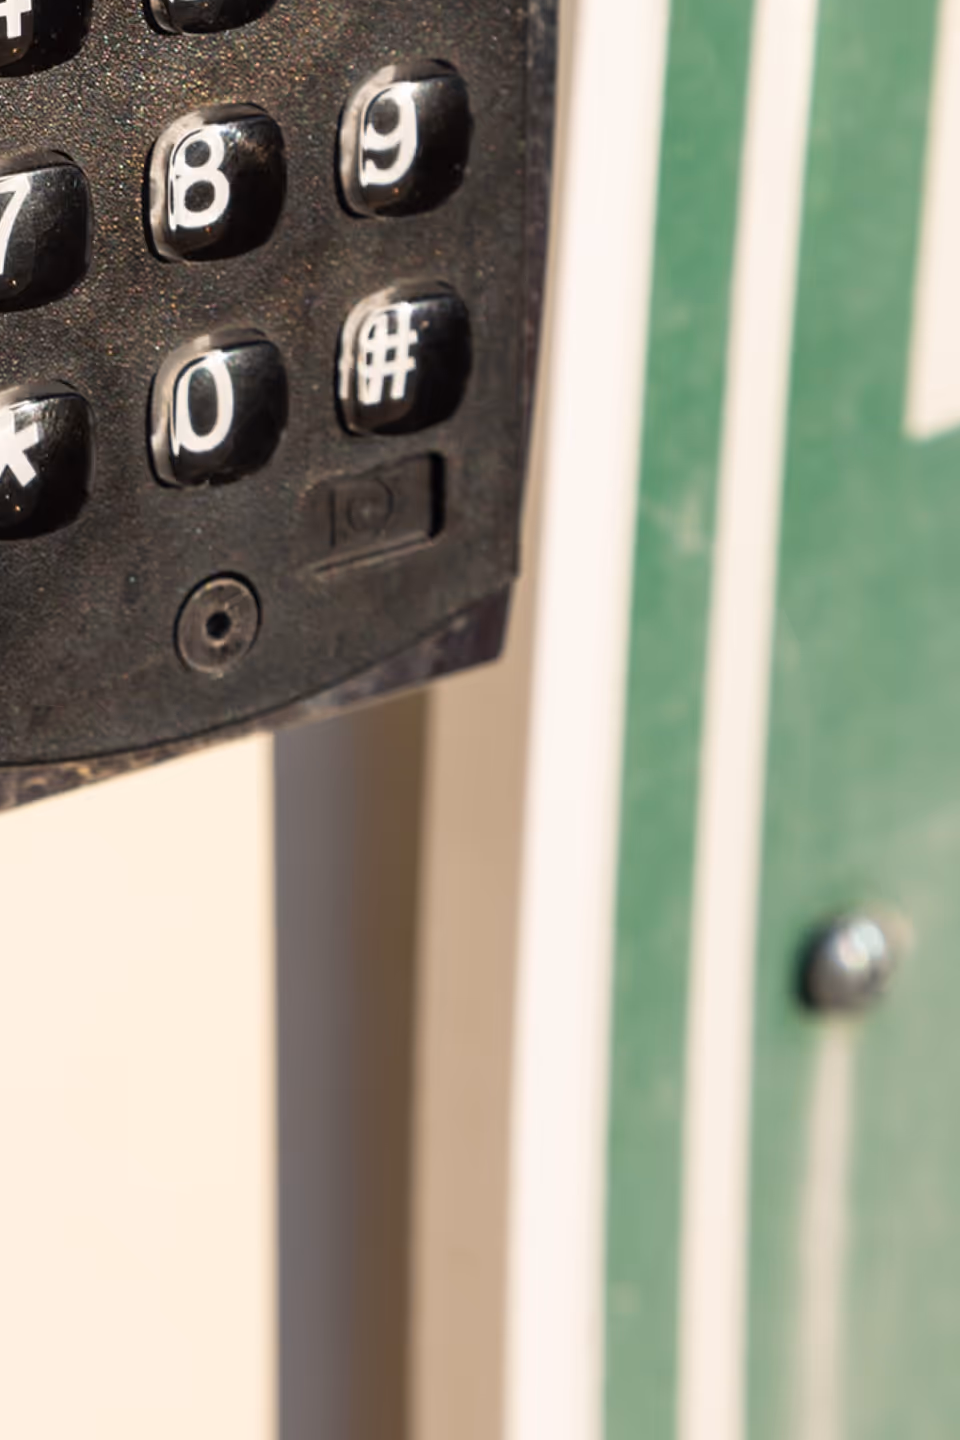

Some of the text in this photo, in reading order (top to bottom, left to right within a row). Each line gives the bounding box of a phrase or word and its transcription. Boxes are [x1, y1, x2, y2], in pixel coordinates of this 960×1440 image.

[169, 127, 231, 231] 8
[359, 81, 419, 187] 9
[172, 351, 235, 457] 0
[357, 302, 419, 406] #
